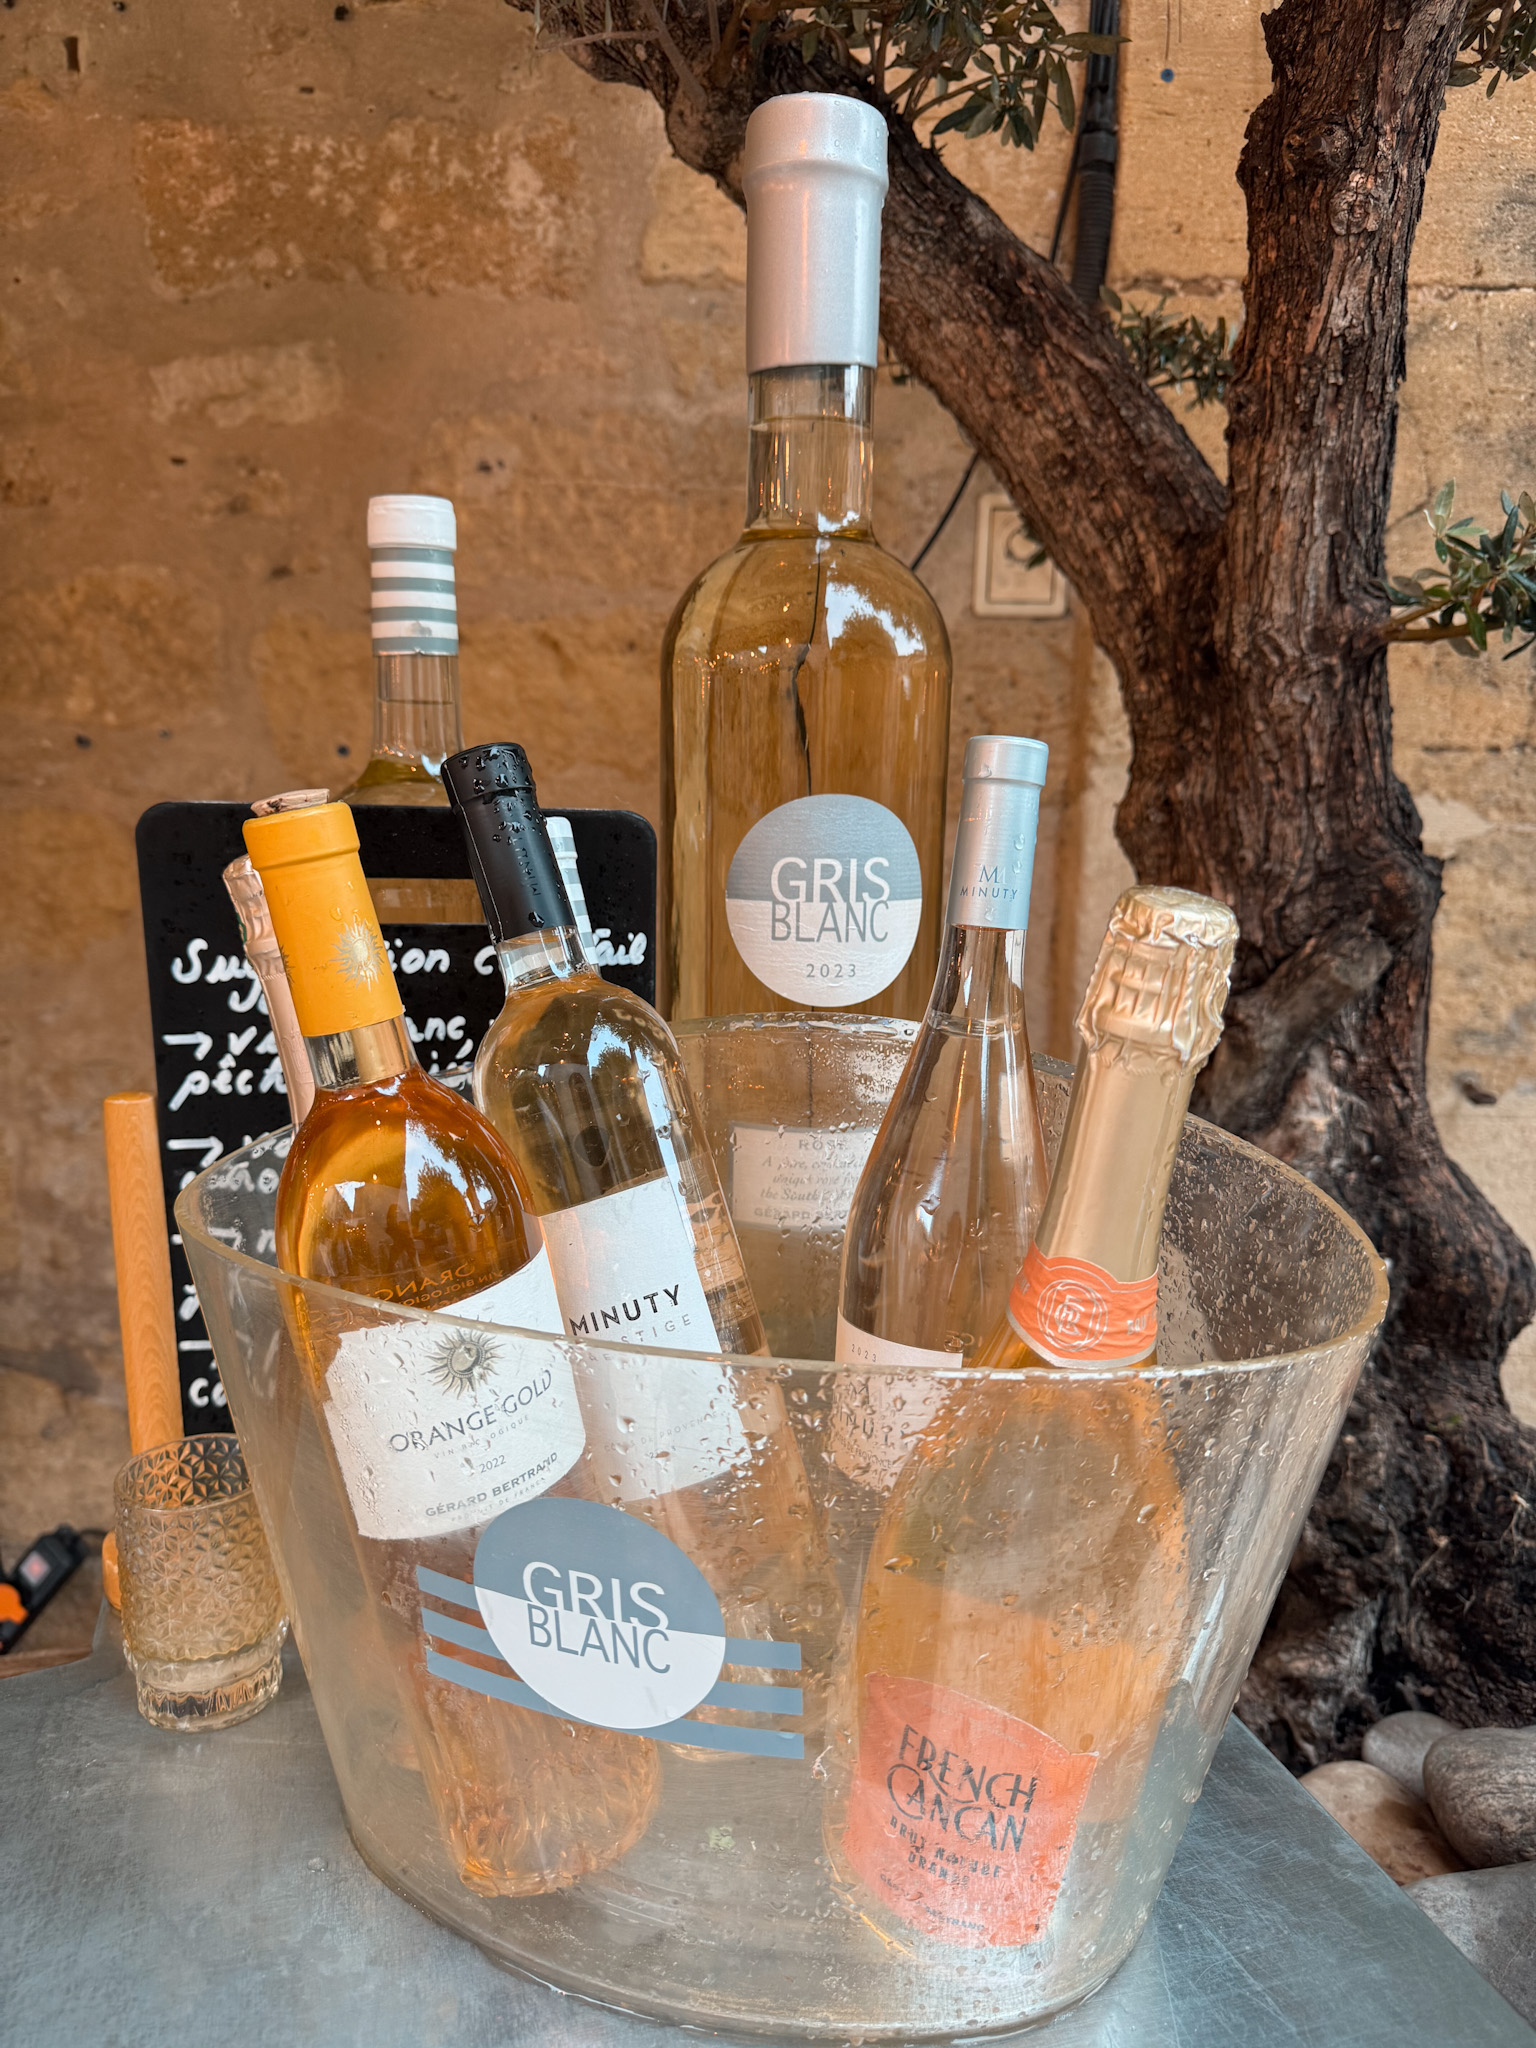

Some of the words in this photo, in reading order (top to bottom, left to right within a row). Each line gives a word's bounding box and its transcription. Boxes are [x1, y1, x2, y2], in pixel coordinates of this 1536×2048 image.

[770, 857, 891, 903] GRIS
[960, 886, 1018, 901] MINUTY
[770, 900, 890, 943] BLANC
[805, 963, 857, 979] 2023
[568, 1284, 680, 1337] MINUTY
[851, 1343, 877, 1363] 2023
[389, 1404, 498, 1453] ORANGE
[502, 1369, 553, 1414] GOLD
[425, 1491, 488, 1517] GÉRARD
[492, 1452, 558, 1498] BERTRAND
[479, 1454, 506, 1474] 2022
[523, 1561, 669, 1630] GRIS
[527, 1602, 670, 1674] BLANC
[898, 1723, 1038, 1813] FRENCH
[886, 1763, 1027, 1853] CANCAN
